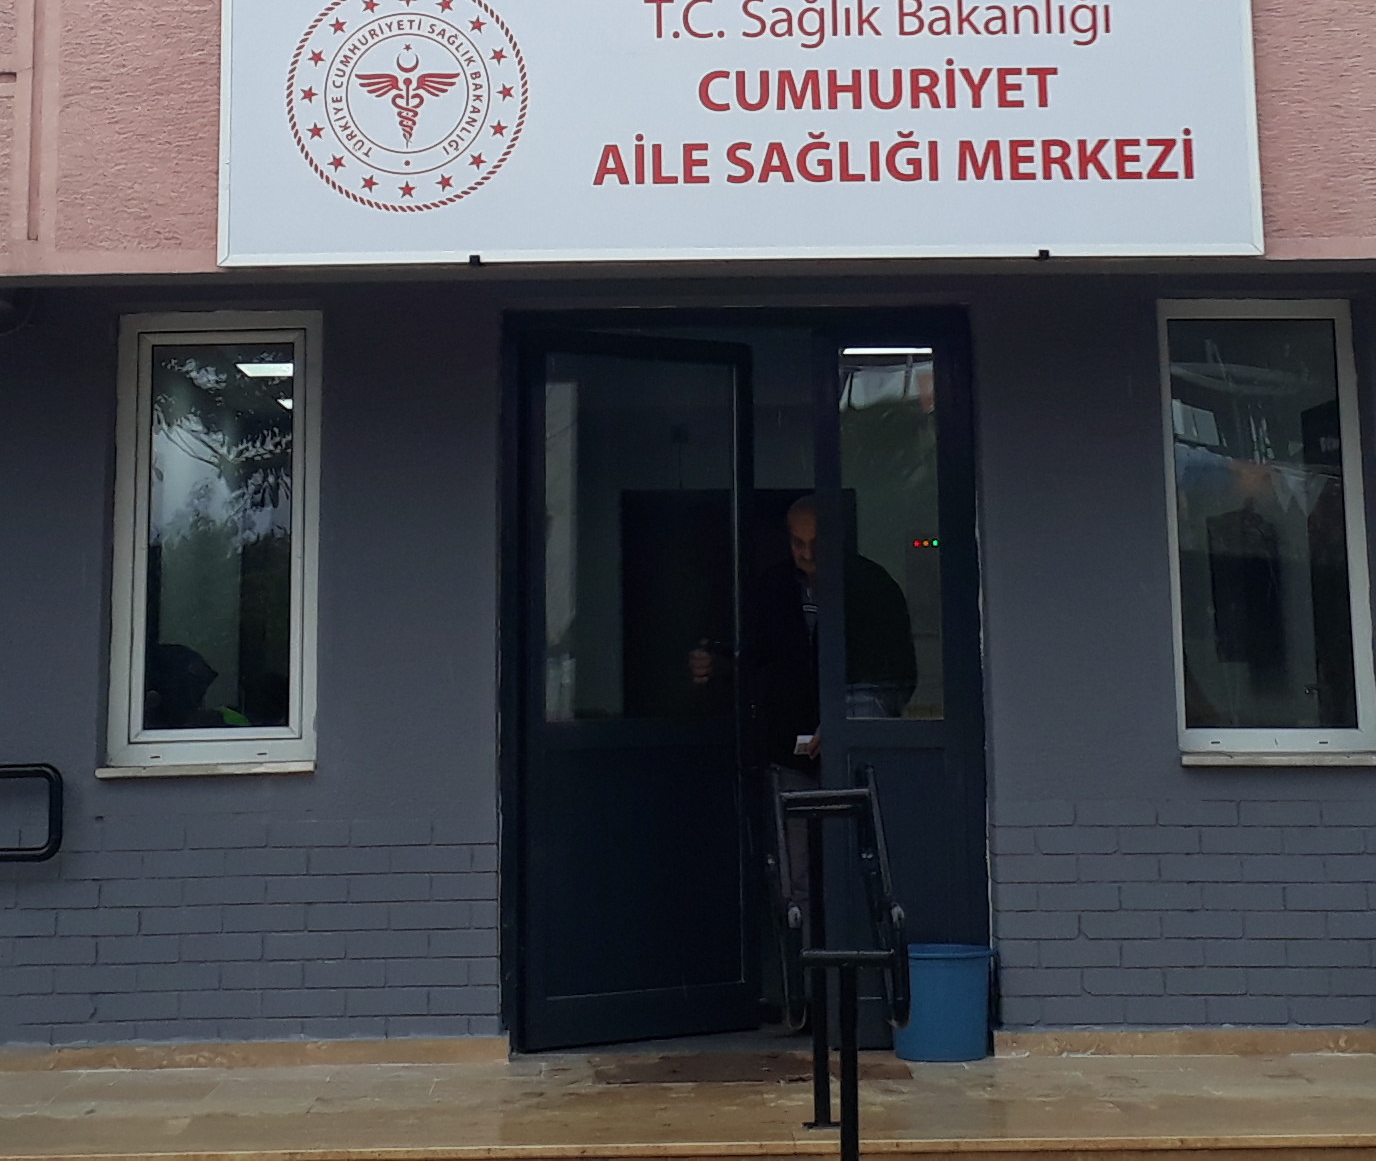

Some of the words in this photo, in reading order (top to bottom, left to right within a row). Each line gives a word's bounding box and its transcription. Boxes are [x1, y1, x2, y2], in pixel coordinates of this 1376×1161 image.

[332, 17, 422, 89] CUMHURİYETİ
[427, 22, 476, 67] SAĞLIK
[442, 70, 484, 156] BAKANLIĞI
[698, 58, 1060, 112] CUMHURİYET
[331, 95, 373, 158] TÜRKİYE
[593, 134, 711, 186] AİLE
[726, 131, 940, 184] SAĞLIĞI
[957, 128, 1196, 181] MERKEZİ
